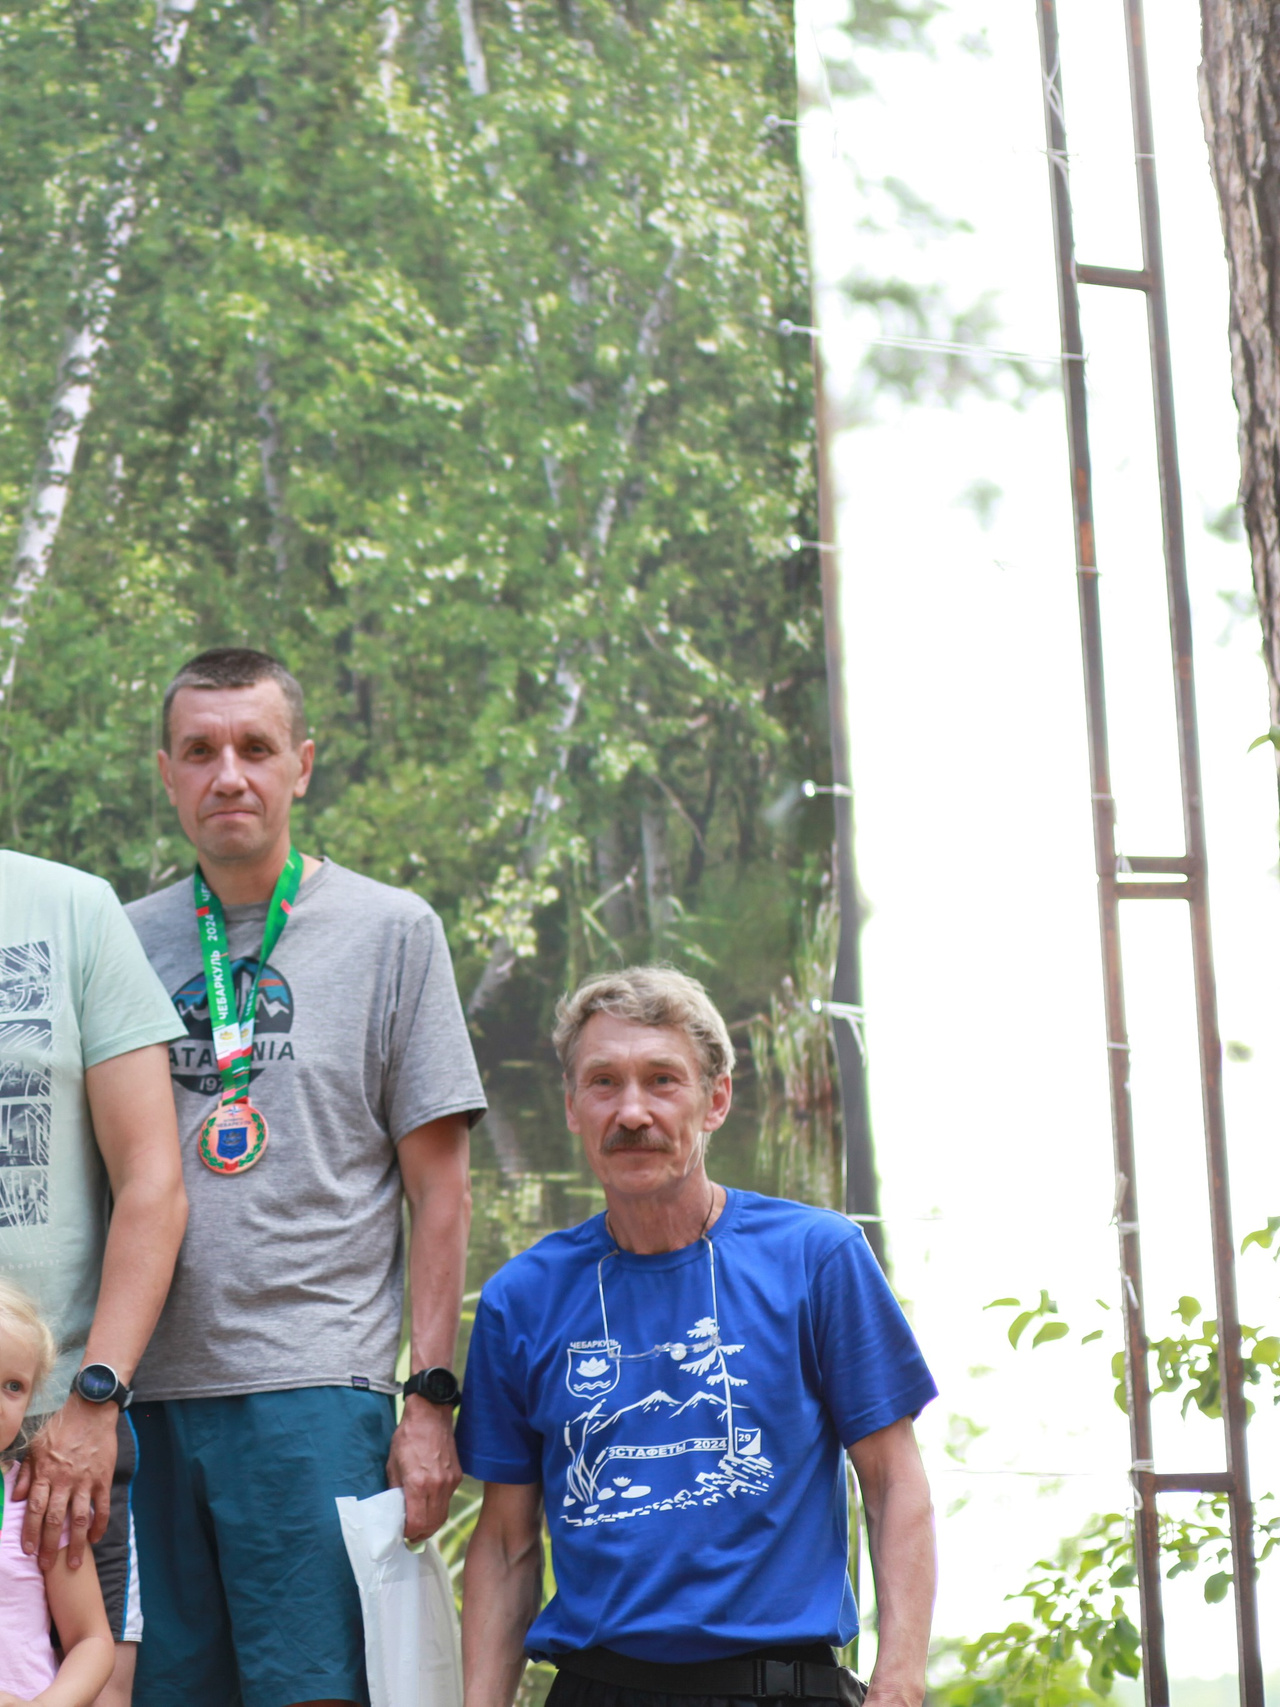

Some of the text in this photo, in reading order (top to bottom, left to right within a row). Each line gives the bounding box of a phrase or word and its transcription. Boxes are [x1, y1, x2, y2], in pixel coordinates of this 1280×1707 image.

[205, 914, 218, 942] 2024
[210, 950, 229, 1020] ЧЕБАРКУЛЬ
[169, 1040, 295, 1068] ATANIA
[607, 1438, 728, 1458] ЭСТАФЕТЫ 2024
[737, 1433, 752, 1443] 29
